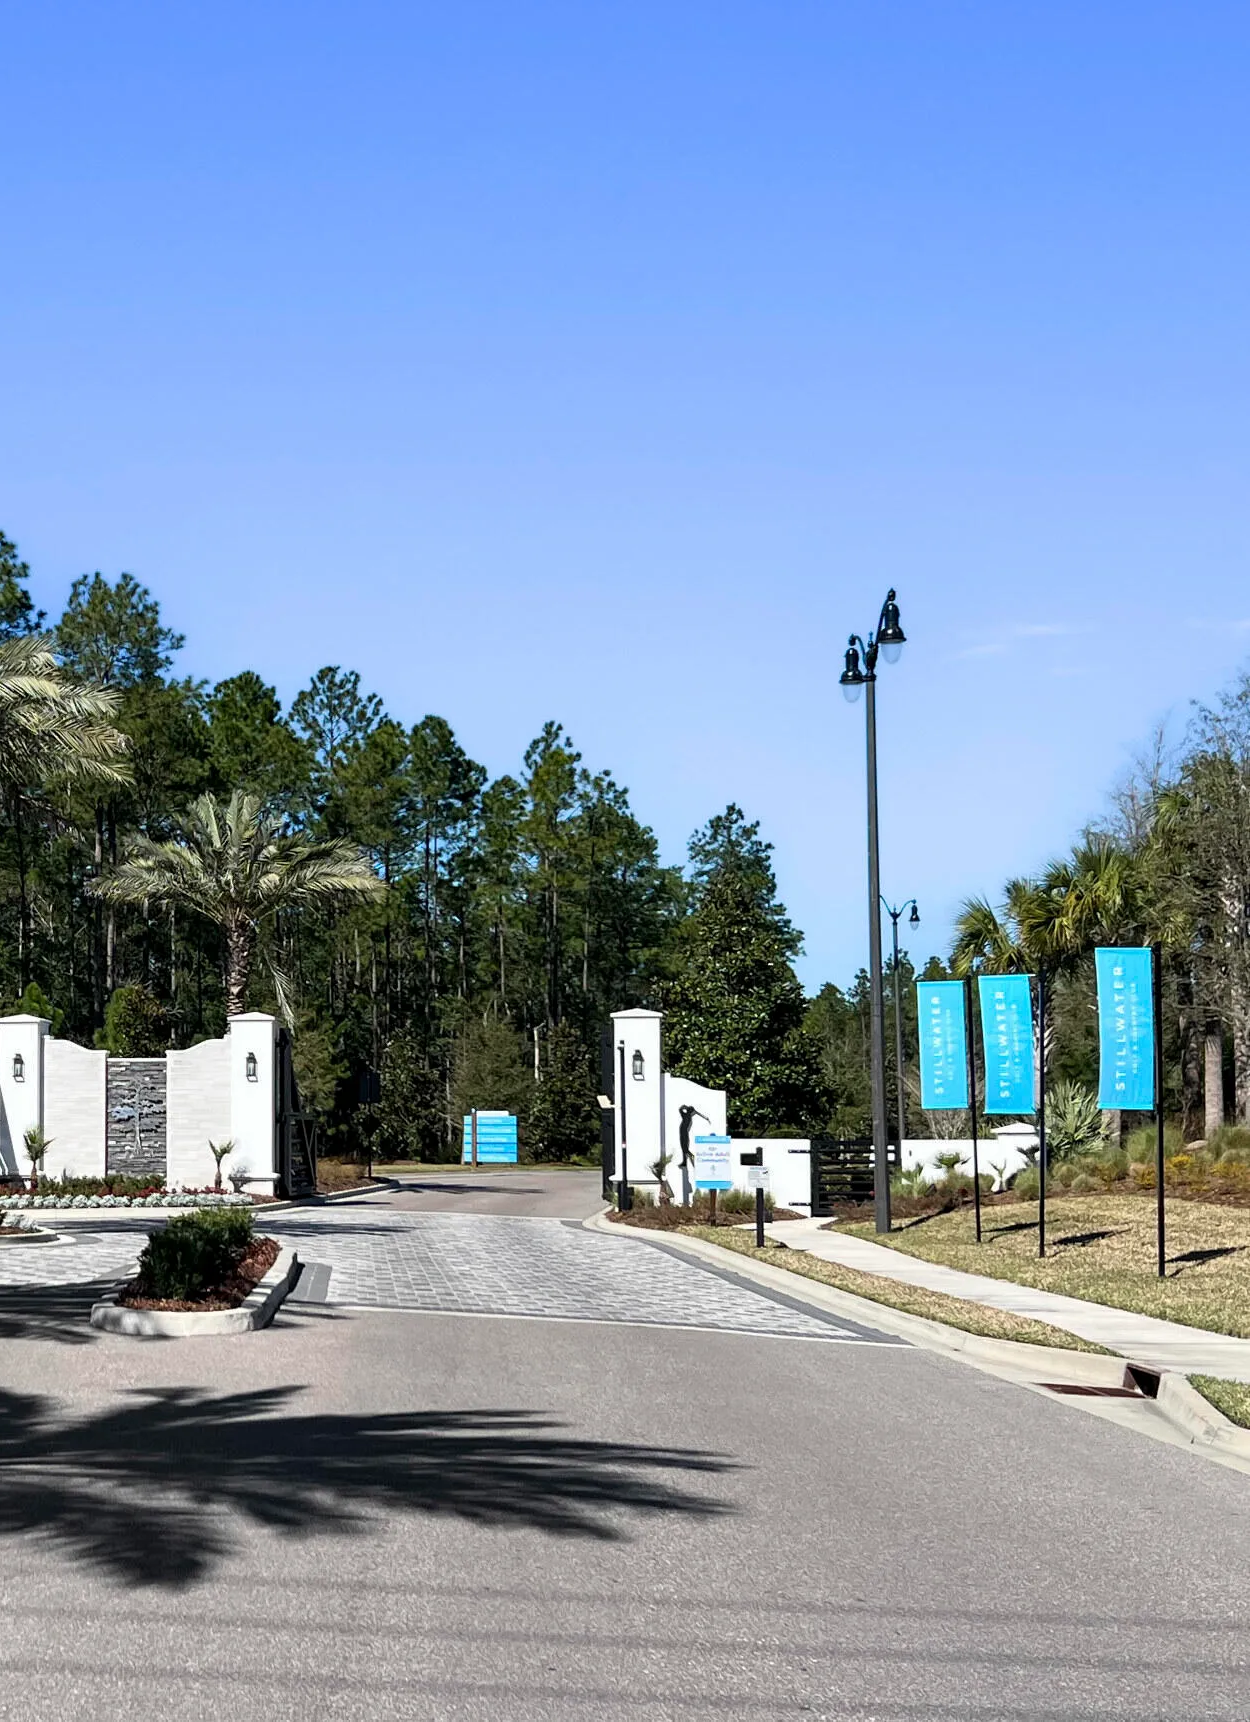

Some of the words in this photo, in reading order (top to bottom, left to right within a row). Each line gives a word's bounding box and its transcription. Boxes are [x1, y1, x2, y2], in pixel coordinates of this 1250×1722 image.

[931, 996, 945, 1095] STILLWATER
[995, 991, 1009, 1098] STILLWATER
[1114, 966, 1127, 1091] STILLWATER
